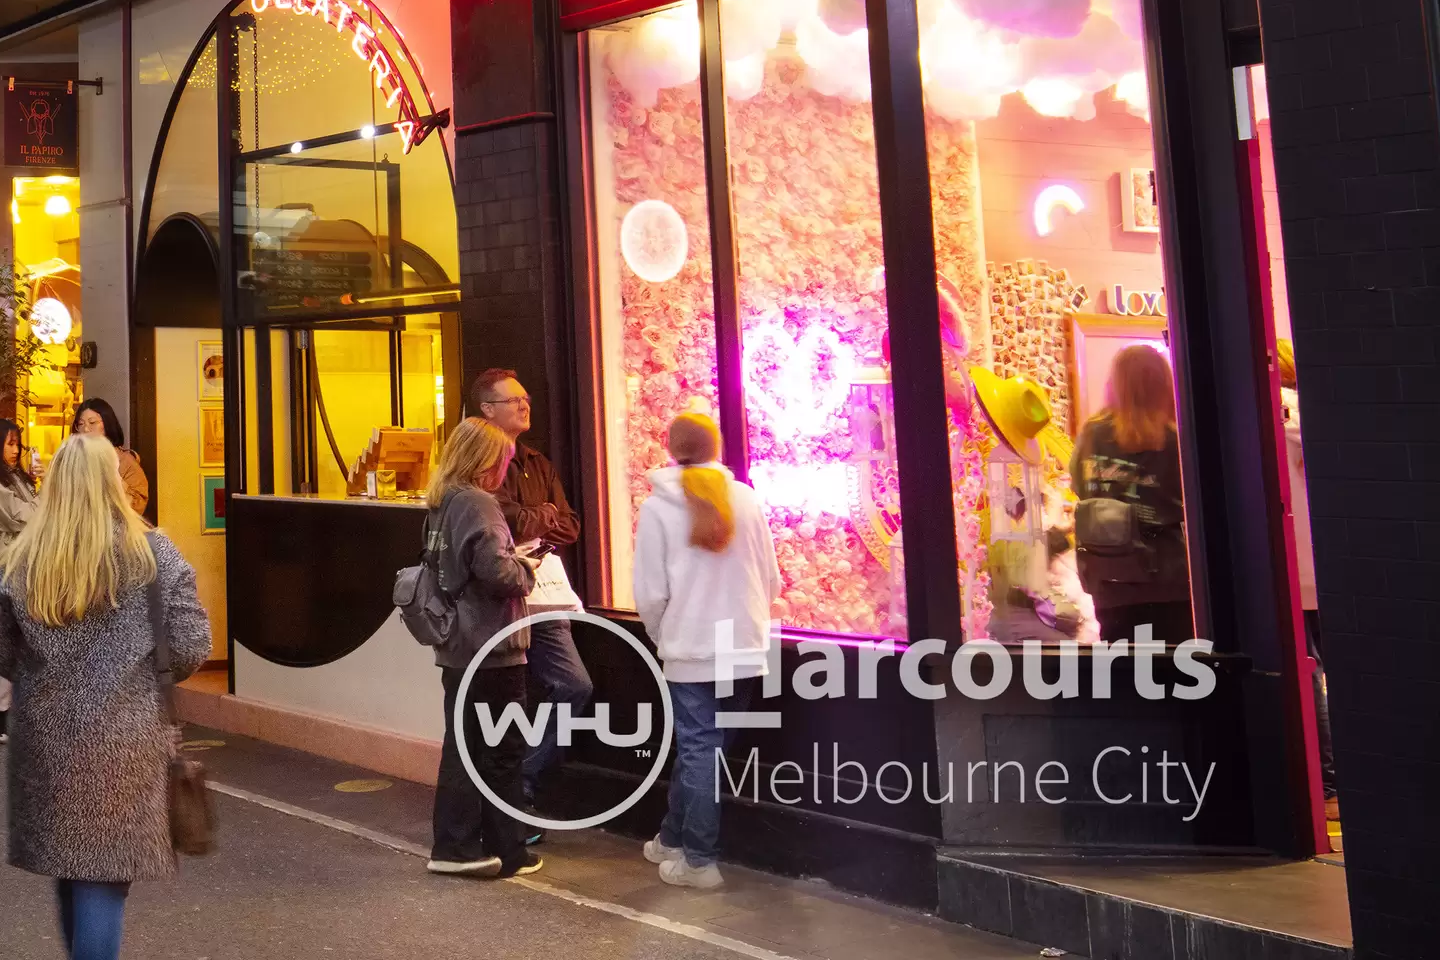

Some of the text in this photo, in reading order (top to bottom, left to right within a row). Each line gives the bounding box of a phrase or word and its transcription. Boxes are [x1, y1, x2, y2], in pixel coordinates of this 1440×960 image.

[20, 144, 64, 156] IL PAPIRO
[25, 156, 56, 164] FIRENZE
